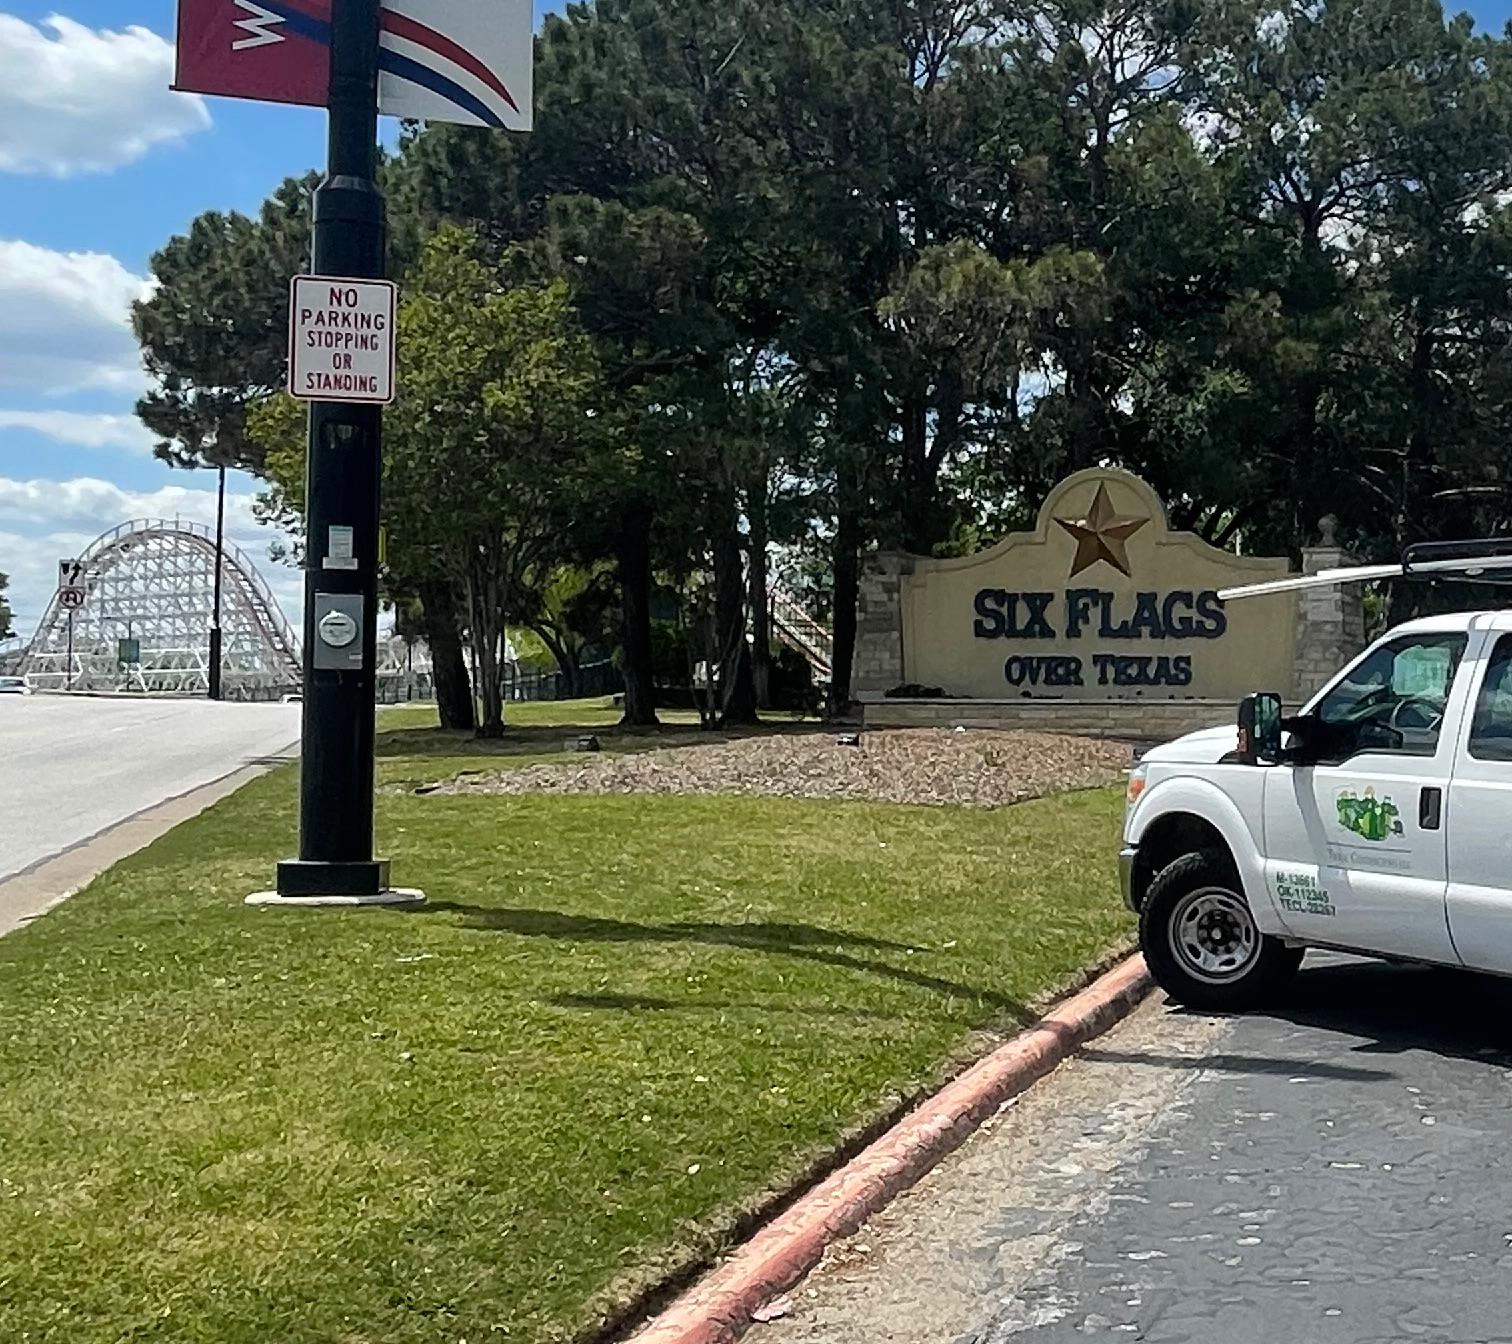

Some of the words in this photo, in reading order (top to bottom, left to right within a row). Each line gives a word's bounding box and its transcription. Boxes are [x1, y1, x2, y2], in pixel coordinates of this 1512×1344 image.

[329, 287, 358, 307] NO
[301, 309, 385, 331] PARKING
[306, 330, 379, 351] STOPPING
[332, 353, 352, 370] OR
[306, 372, 378, 393] STANDING
[974, 589, 1055, 639] SIX
[1066, 588, 1227, 640] FLAGS
[1005, 655, 1083, 687] OVER
[1093, 654, 1192, 686] TEXAS
